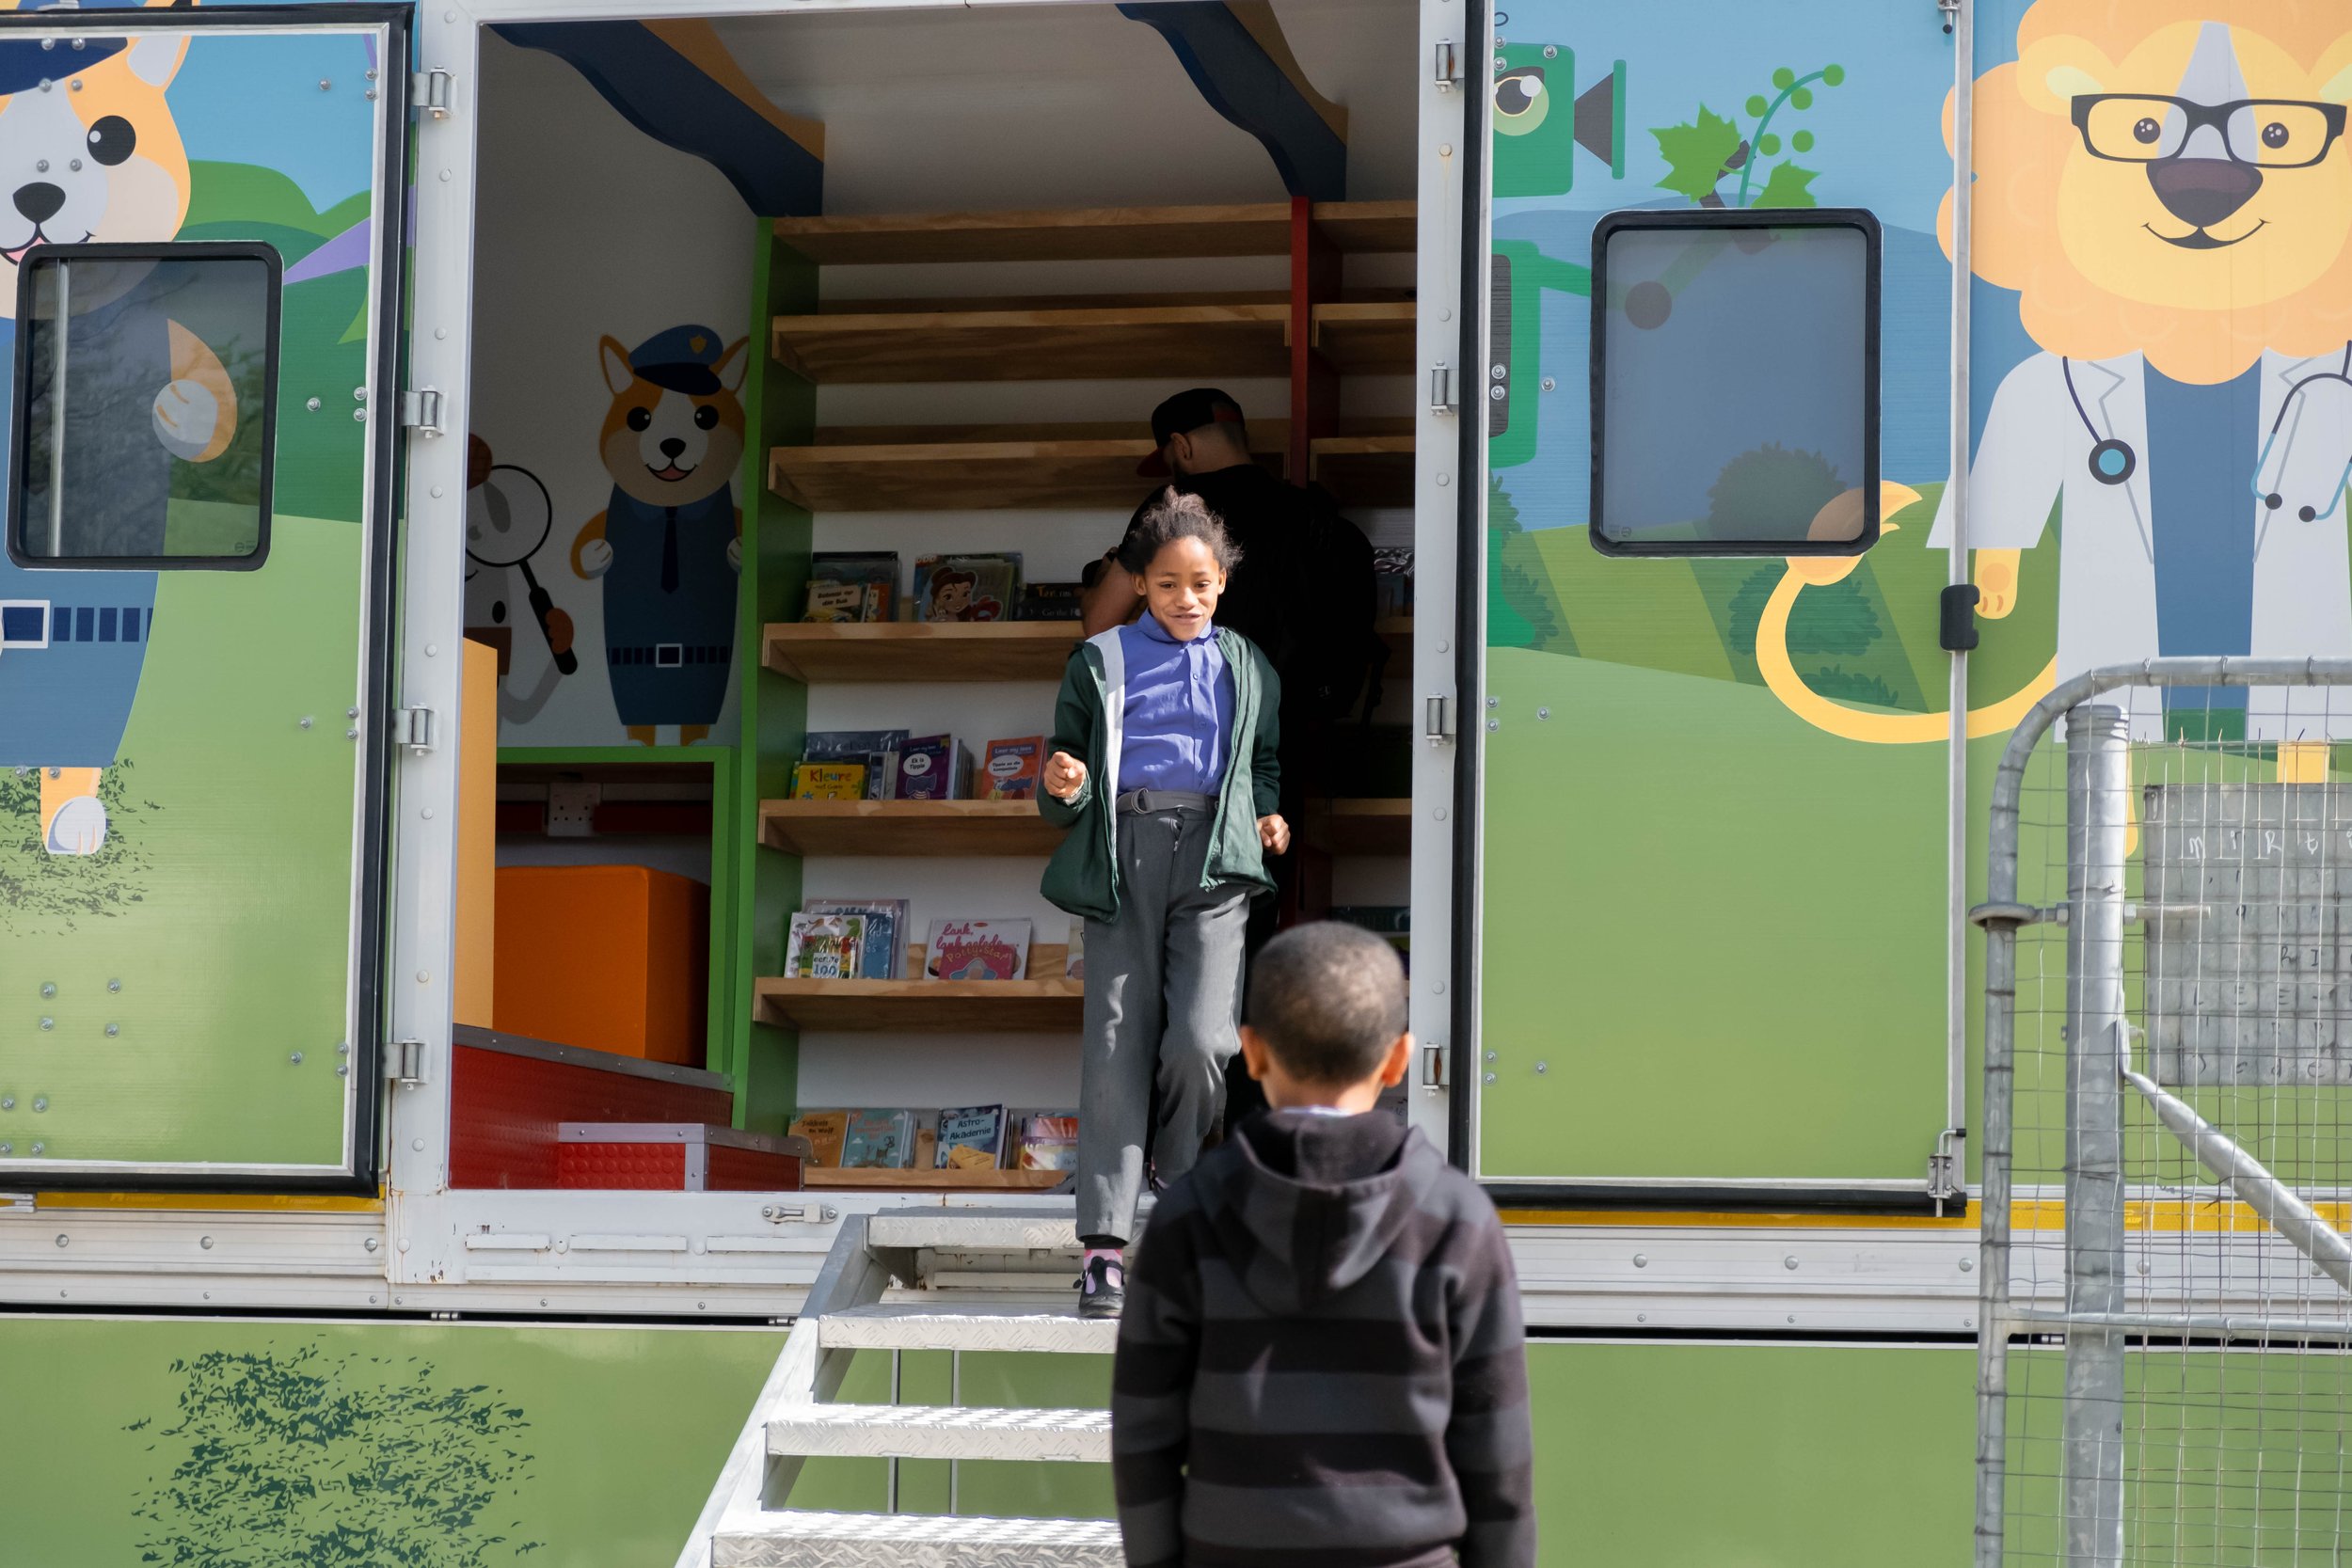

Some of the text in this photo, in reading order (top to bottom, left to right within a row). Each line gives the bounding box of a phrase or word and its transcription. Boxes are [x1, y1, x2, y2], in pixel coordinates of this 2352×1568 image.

[810, 768, 851, 783] Kleure
[814, 964, 836, 975] 100
[949, 1127, 992, 1140] Akademie
